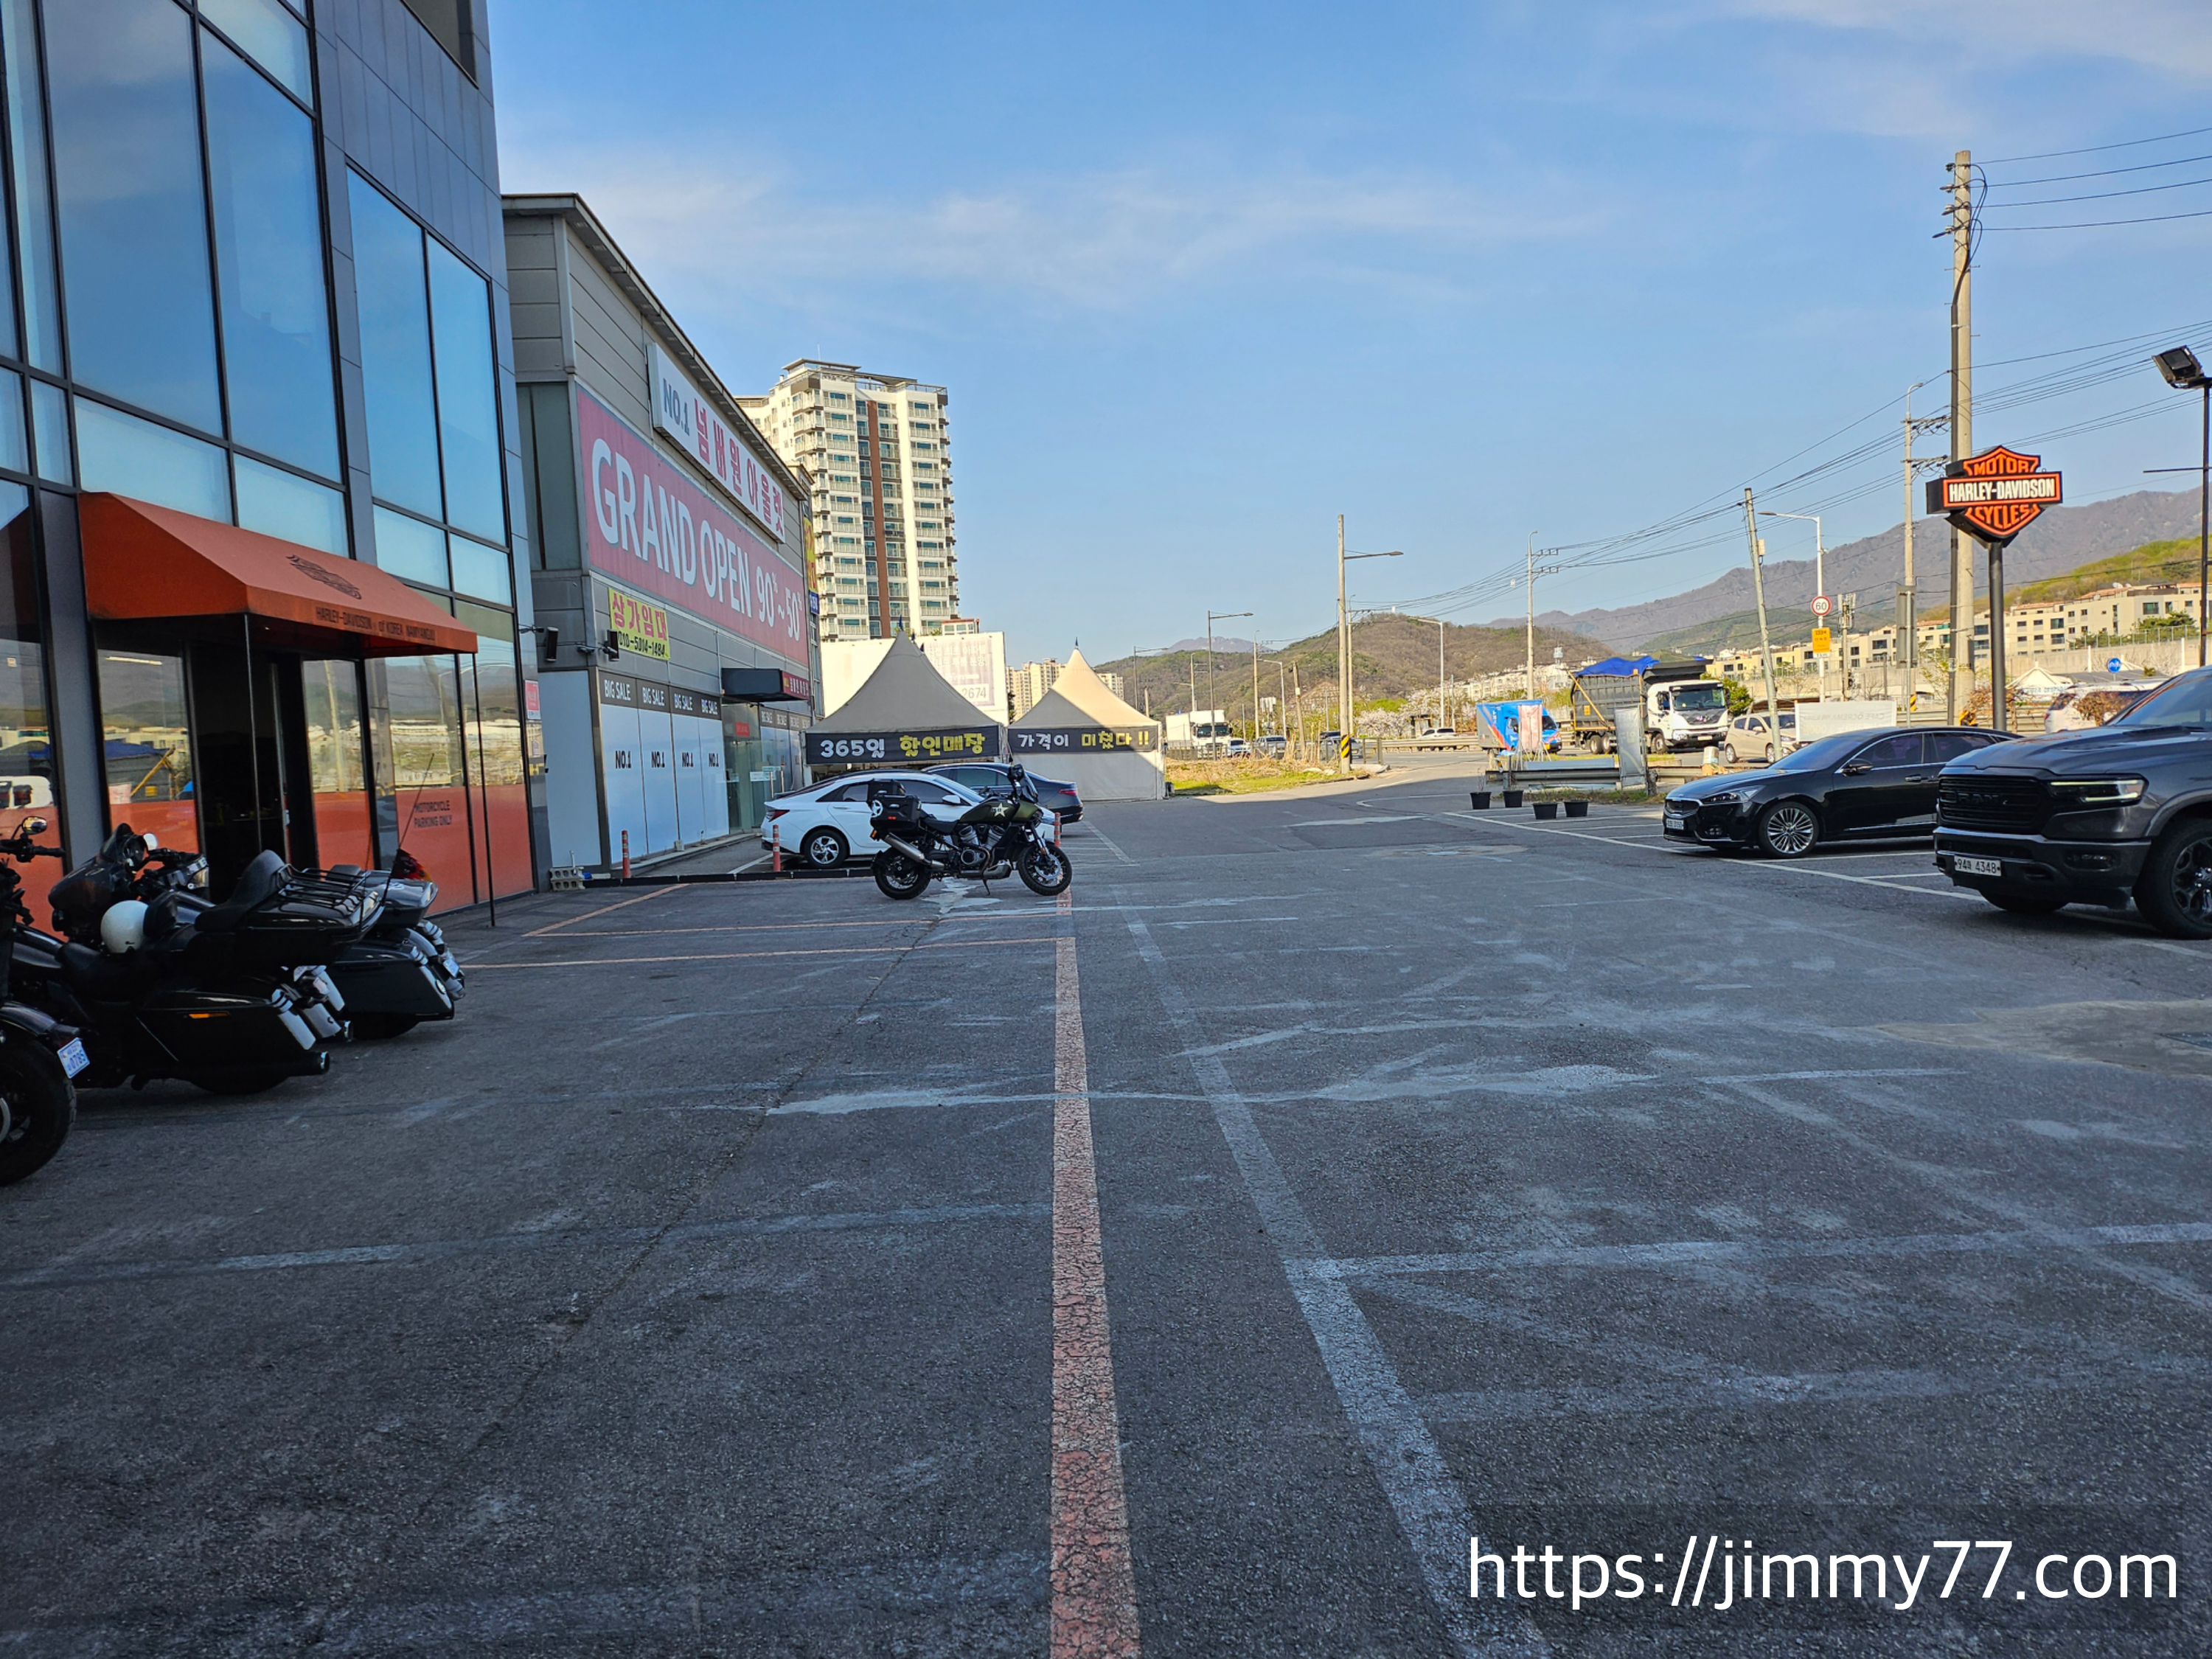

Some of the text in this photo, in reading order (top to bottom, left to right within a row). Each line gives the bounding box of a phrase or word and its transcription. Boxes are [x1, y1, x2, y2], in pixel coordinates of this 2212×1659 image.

[664, 378, 690, 437] NO.1
[1973, 453, 2028, 476] MOTOR
[1949, 479, 2055, 503] HARLEY-DAVIDSON
[1975, 504, 2030, 529] CYCLES
[592, 438, 696, 586] GRAND
[700, 519, 753, 618] OPEN
[613, 592, 667, 641] 상가임대
[1815, 602, 1827, 611] 60
[604, 679, 631, 700] BIG SALE
[642, 686, 665, 706] BIG SALE
[820, 733, 986, 759] 365일 할인매장
[1018, 733, 1069, 751] 가격이
[615, 751, 632, 769] NO.1
[651, 751, 665, 768] NO.1
[681, 752, 694, 768] NO.1
[709, 753, 720, 768] NO.1
[439, 815, 452, 826] ONLY
[1975, 860, 1997, 874] 4348
